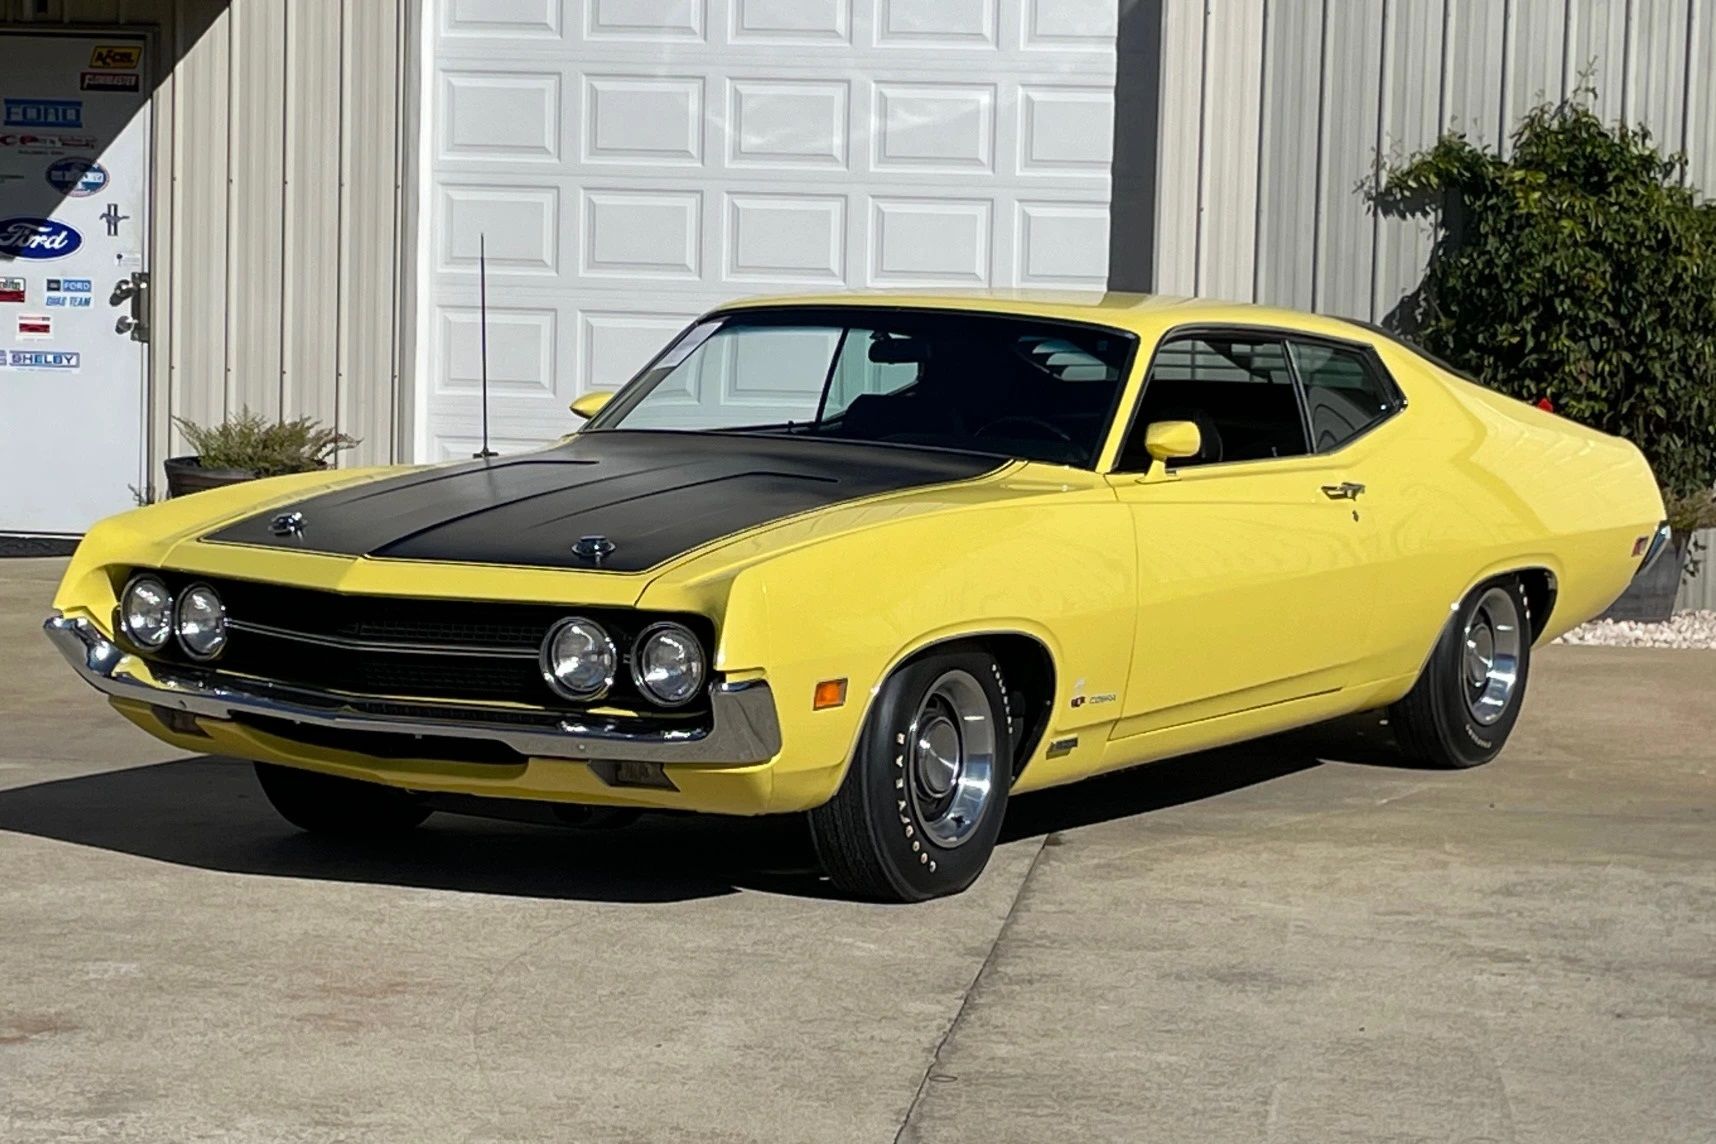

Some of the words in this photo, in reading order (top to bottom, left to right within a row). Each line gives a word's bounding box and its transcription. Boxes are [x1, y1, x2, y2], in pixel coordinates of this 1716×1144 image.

[6, 101, 82, 125] FORD
[0, 222, 69, 250] Ford
[63, 282, 91, 291] FORD
[69, 296, 92, 307] TEAM
[12, 354, 74, 365] SHELBY
